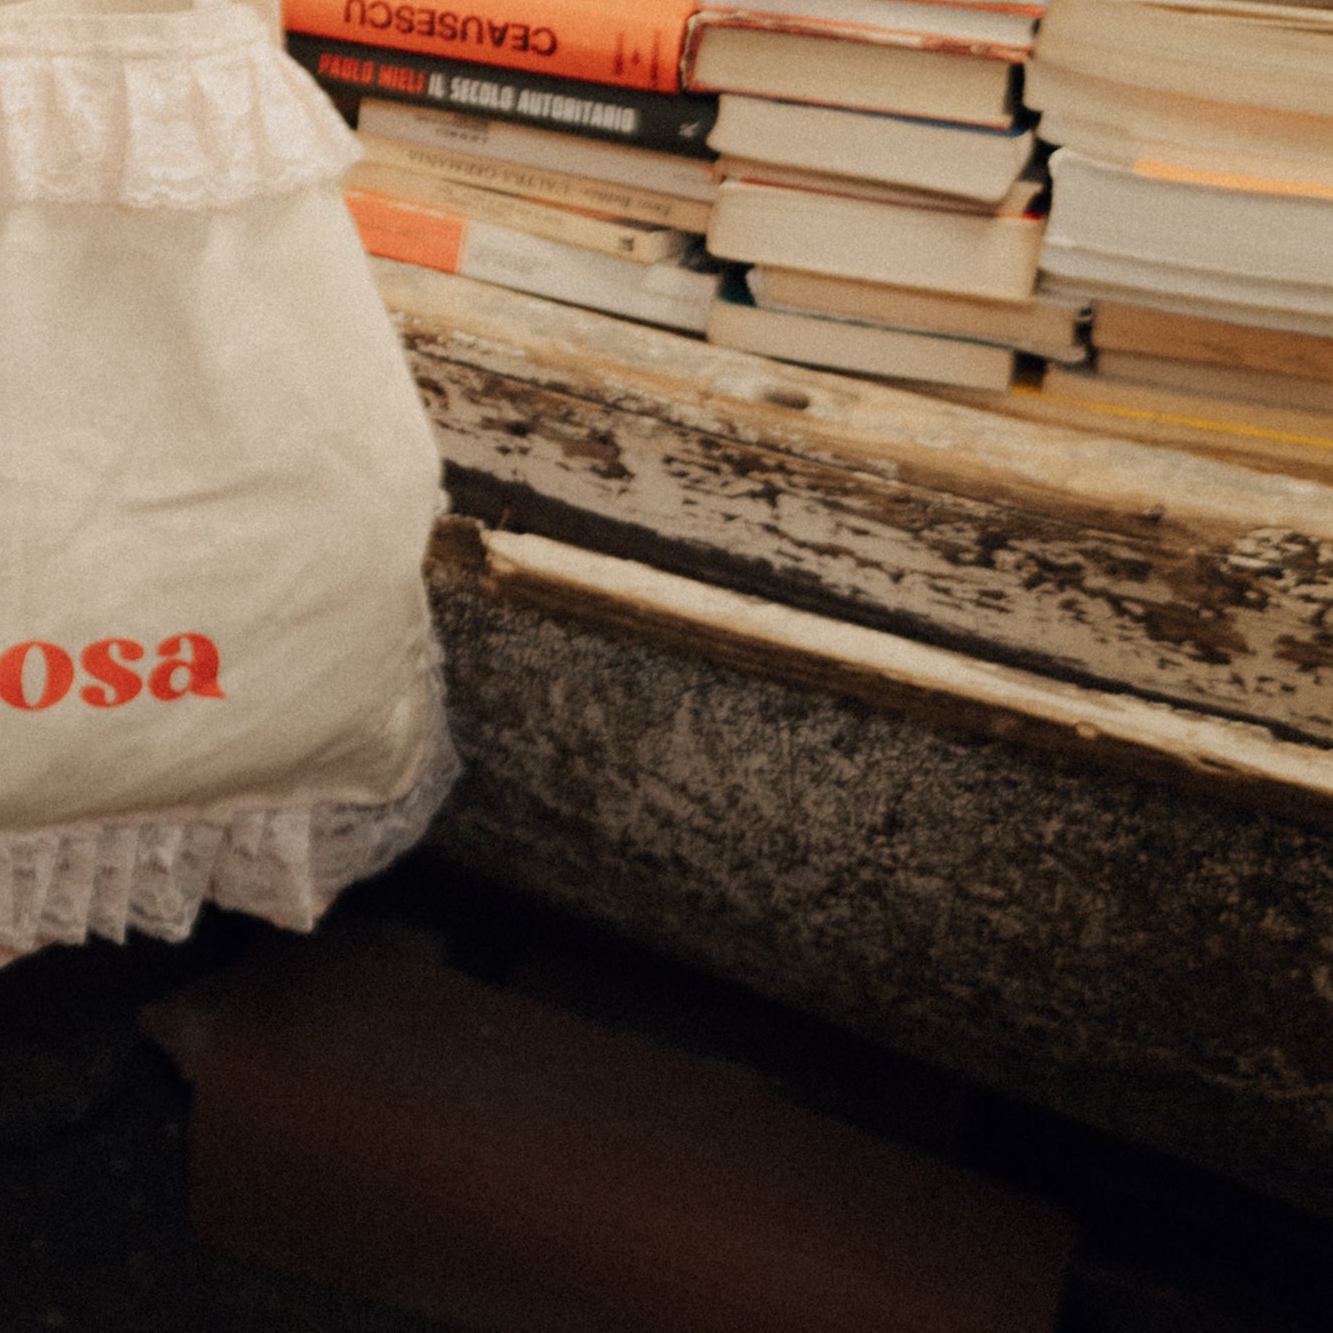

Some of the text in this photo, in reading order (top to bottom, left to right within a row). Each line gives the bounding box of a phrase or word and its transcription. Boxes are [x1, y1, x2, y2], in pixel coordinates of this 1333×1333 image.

[318, 53, 637, 133] PAOLO MIELI IL SECOLO AUTORITARIO
